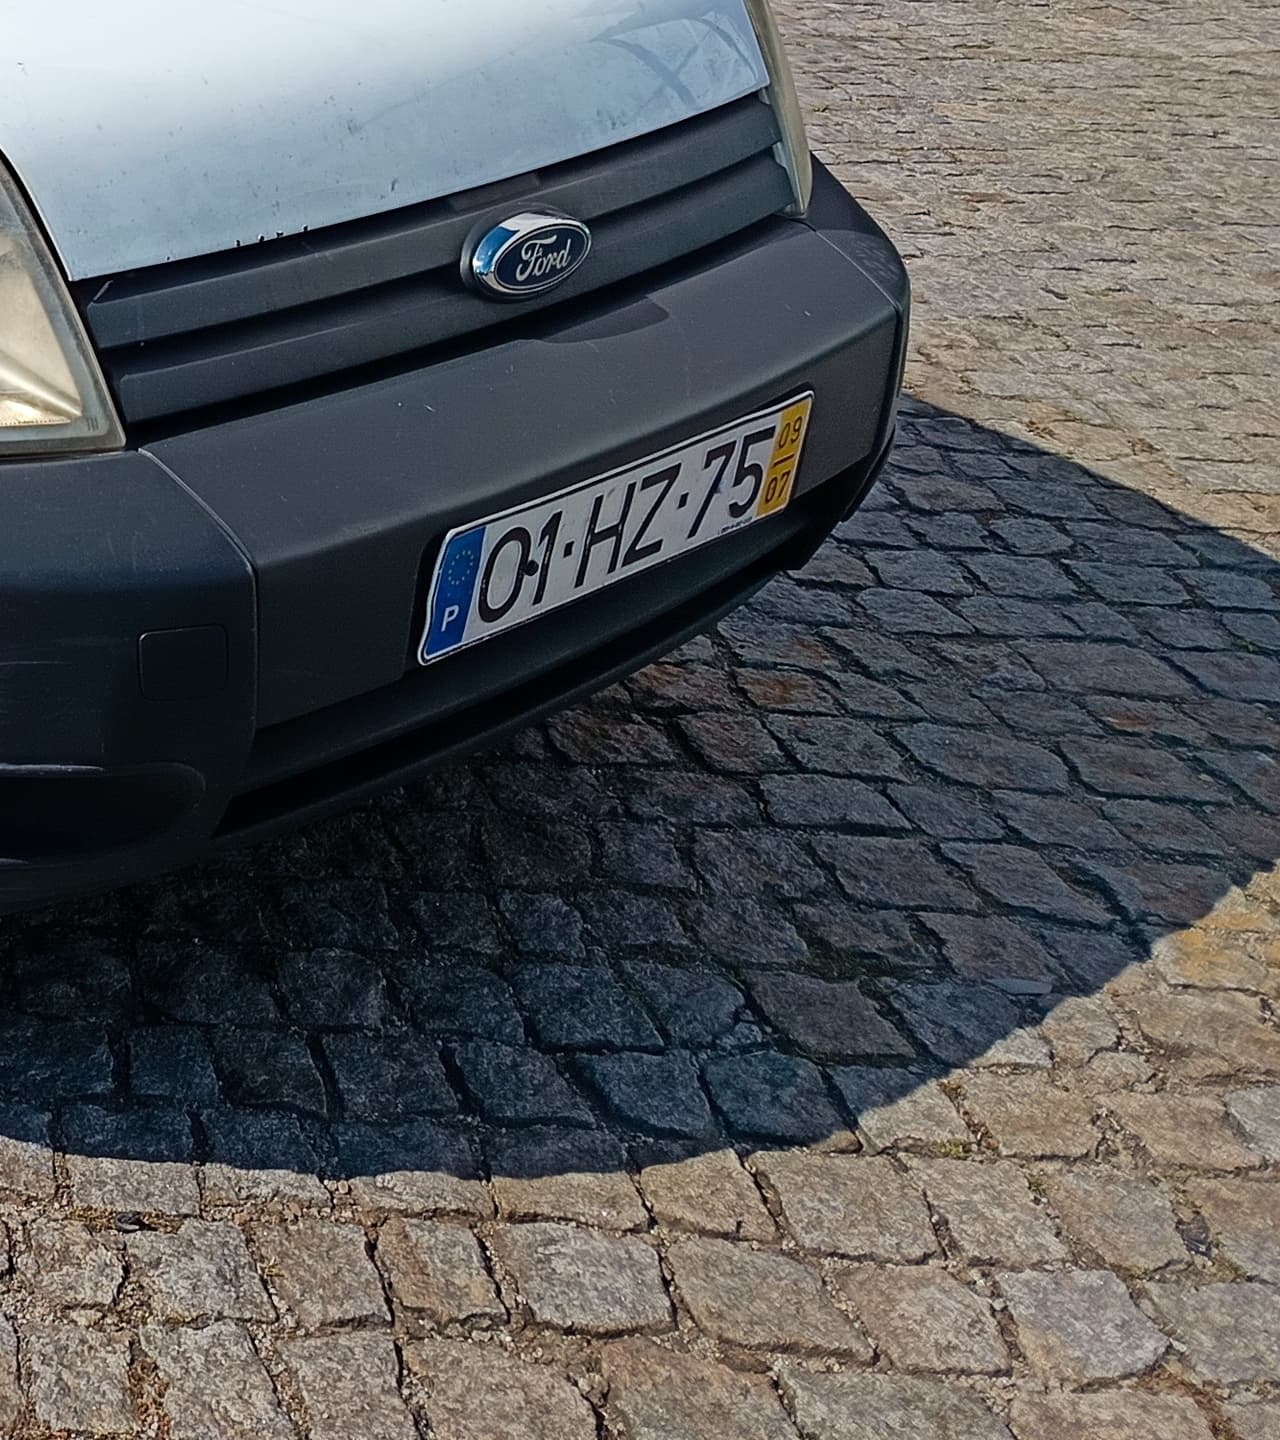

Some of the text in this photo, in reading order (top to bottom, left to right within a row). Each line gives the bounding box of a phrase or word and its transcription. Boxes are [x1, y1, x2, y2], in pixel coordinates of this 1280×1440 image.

[515, 234, 573, 282] Ford
[777, 415, 802, 450] 09
[764, 470, 790, 505] 07
[441, 424, 778, 632] P 01-HZ-75
